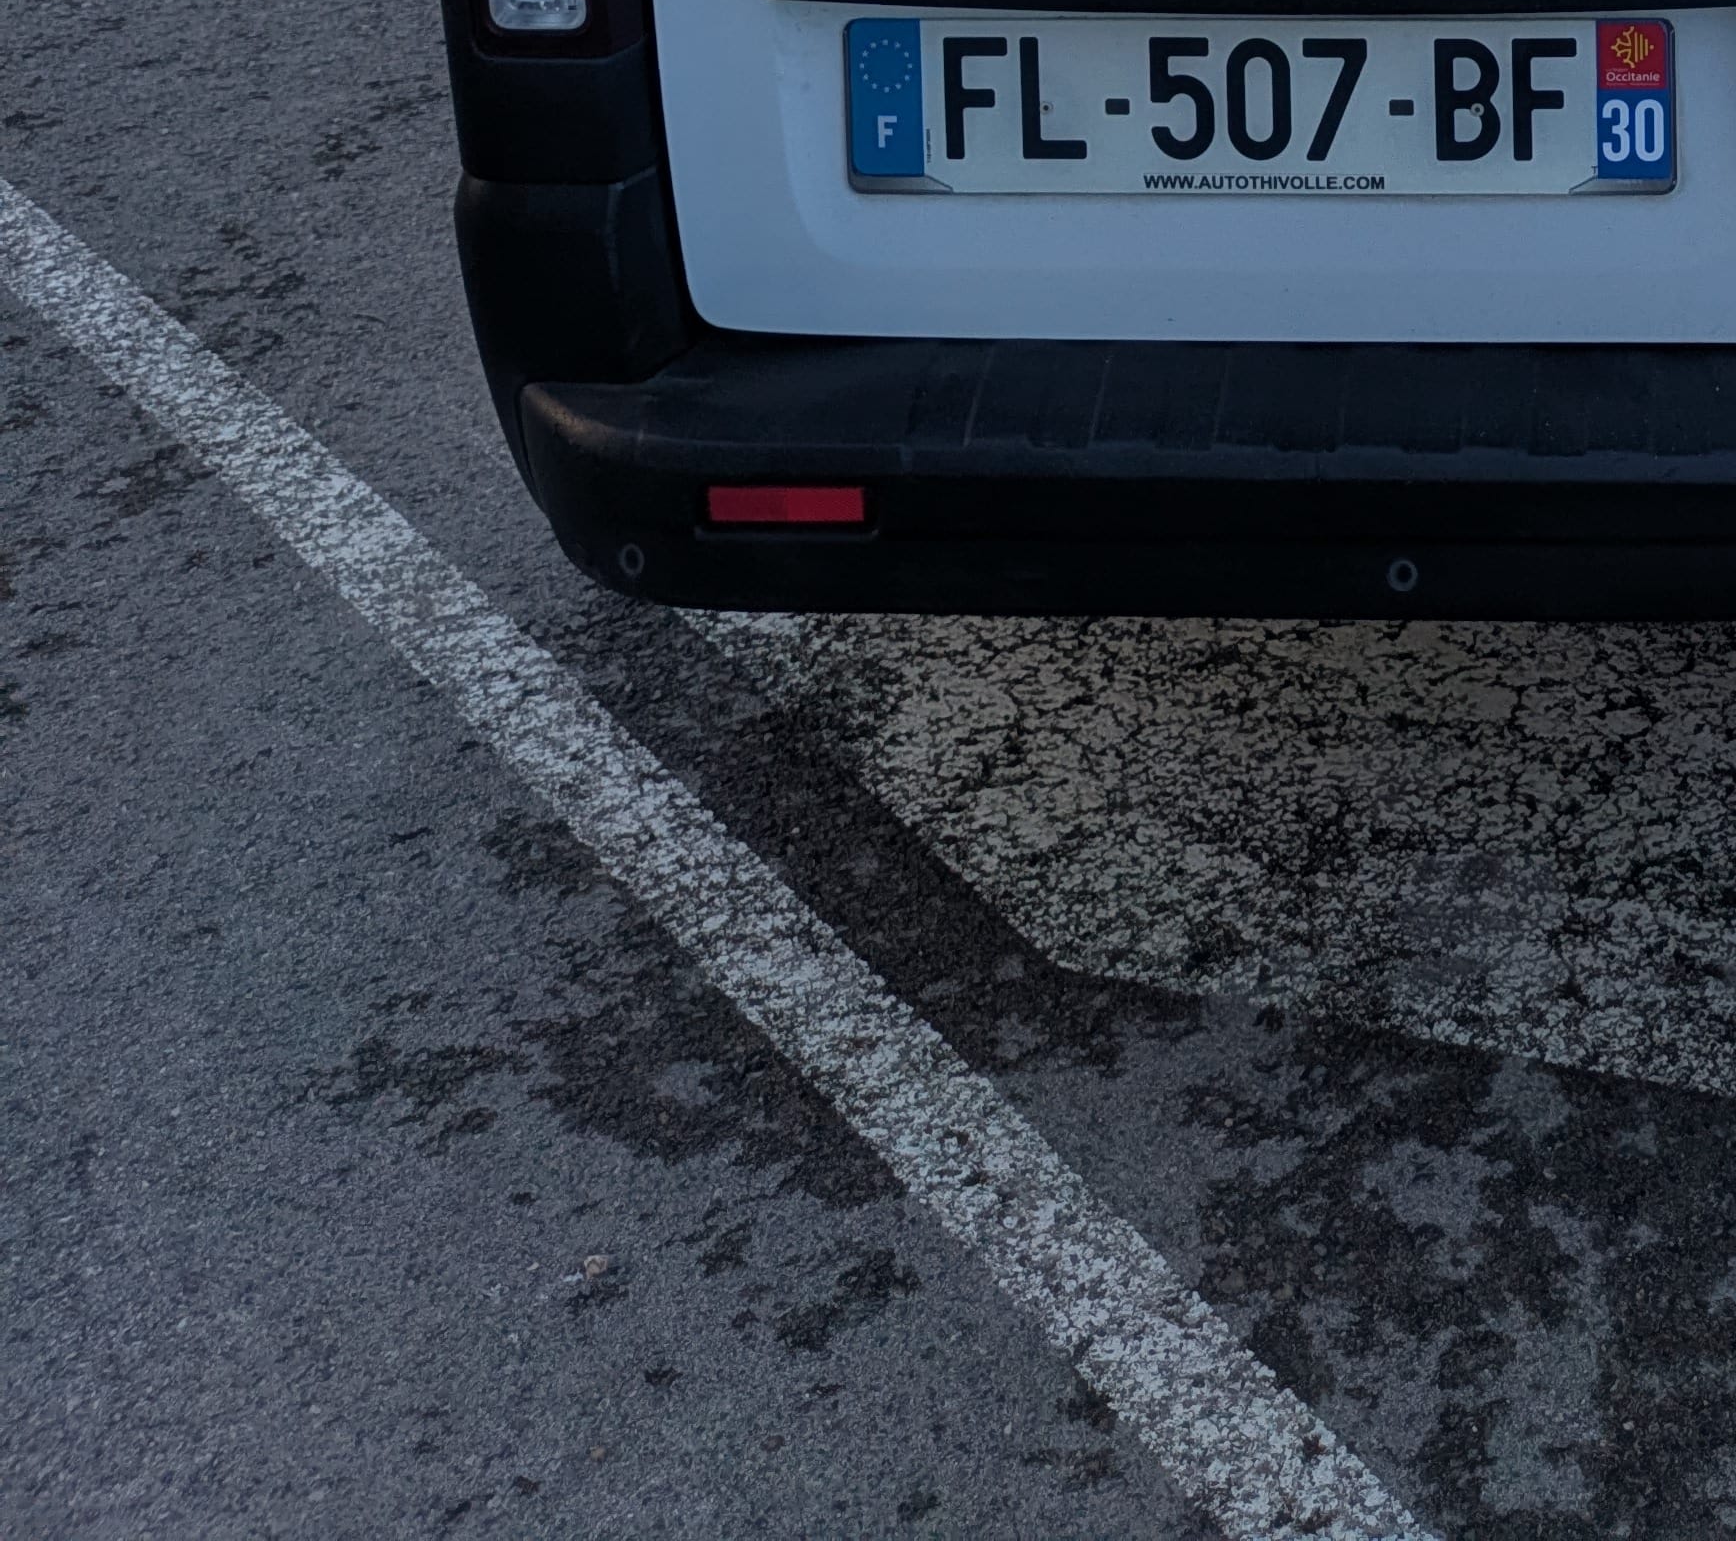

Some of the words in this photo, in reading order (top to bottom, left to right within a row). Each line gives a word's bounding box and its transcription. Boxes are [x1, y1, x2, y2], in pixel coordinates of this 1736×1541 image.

[1606, 71, 1660, 82] Occitanie
[943, 36, 1577, 162] FL-507-BF
[877, 115, 898, 149] F
[1602, 98, 1664, 162] 30
[1143, 174, 1386, 190] WWW.AUTOTHIVOLLE.COM
